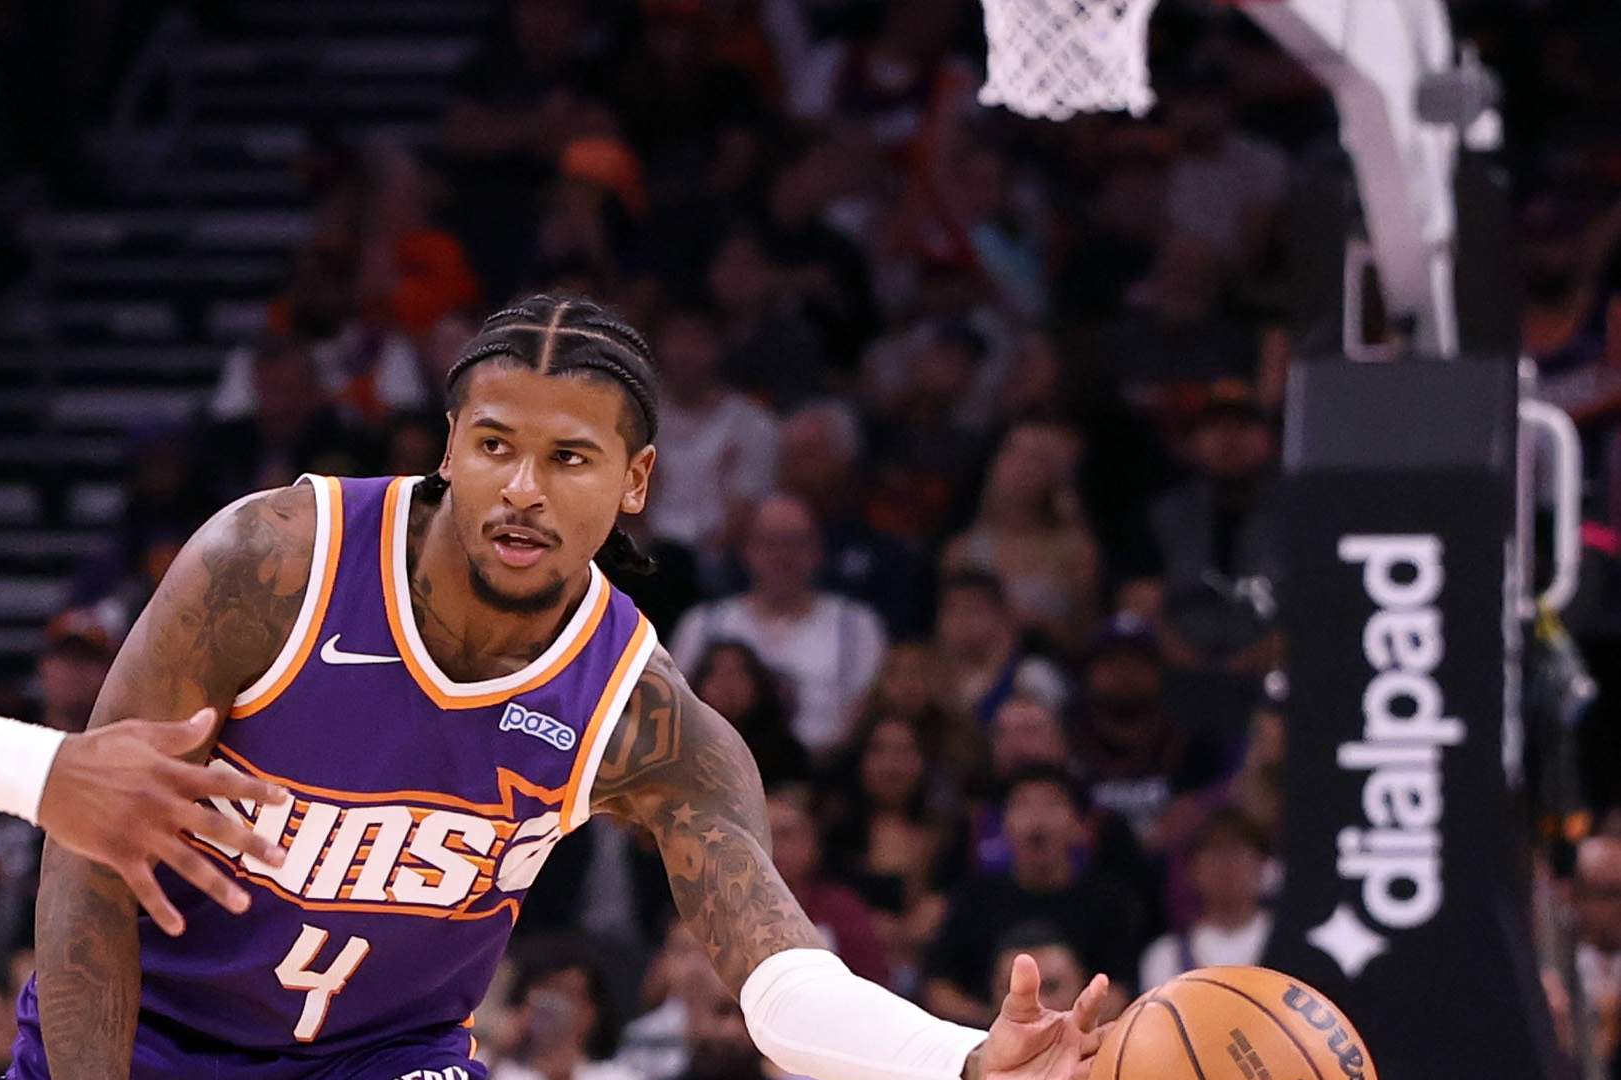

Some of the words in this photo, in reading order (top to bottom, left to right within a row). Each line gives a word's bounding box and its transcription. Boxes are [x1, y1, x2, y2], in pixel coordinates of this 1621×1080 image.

[501, 704, 574, 748] paze
[1336, 533, 1467, 928] dialpad
[273, 922, 371, 1043] 4
